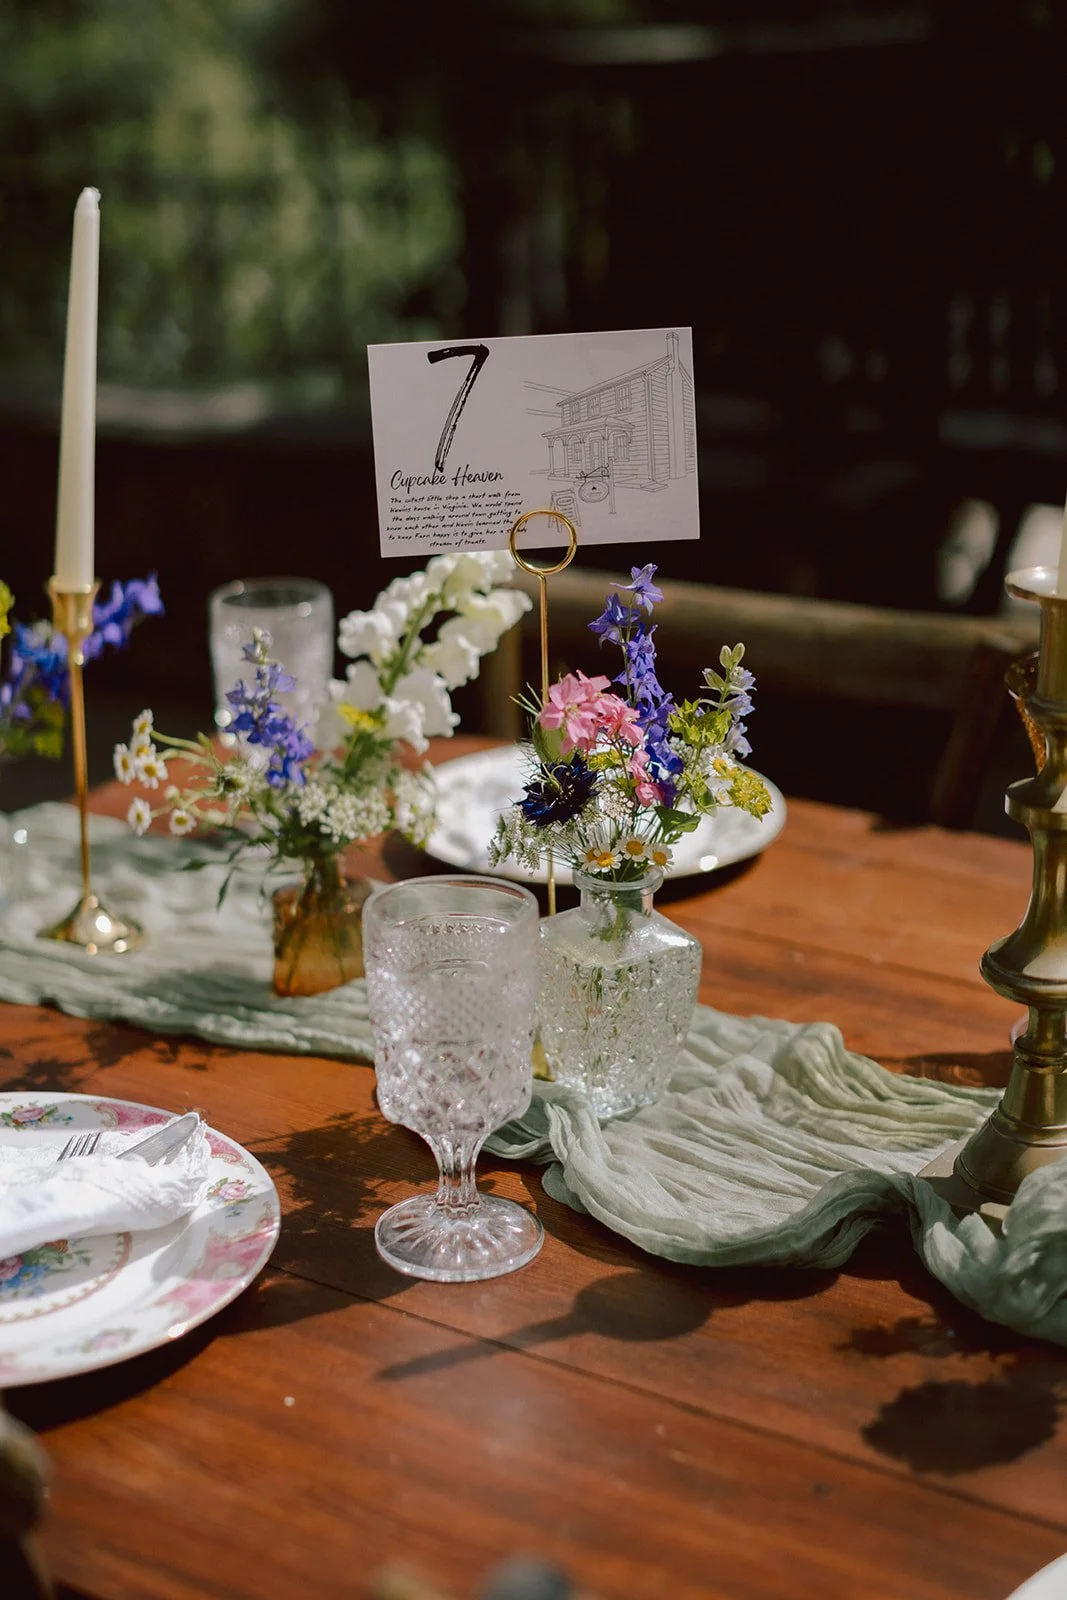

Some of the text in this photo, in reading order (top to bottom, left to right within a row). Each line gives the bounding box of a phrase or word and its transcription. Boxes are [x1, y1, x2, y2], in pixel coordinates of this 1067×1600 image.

[427, 344, 490, 473] 7
[391, 464, 504, 494] Cupcake Heaven
[504, 490, 521, 499] from
[442, 502, 468, 512] Virginia.
[423, 512, 445, 522] walking
[468, 529, 482, 538] give
[455, 539, 463, 547] of
